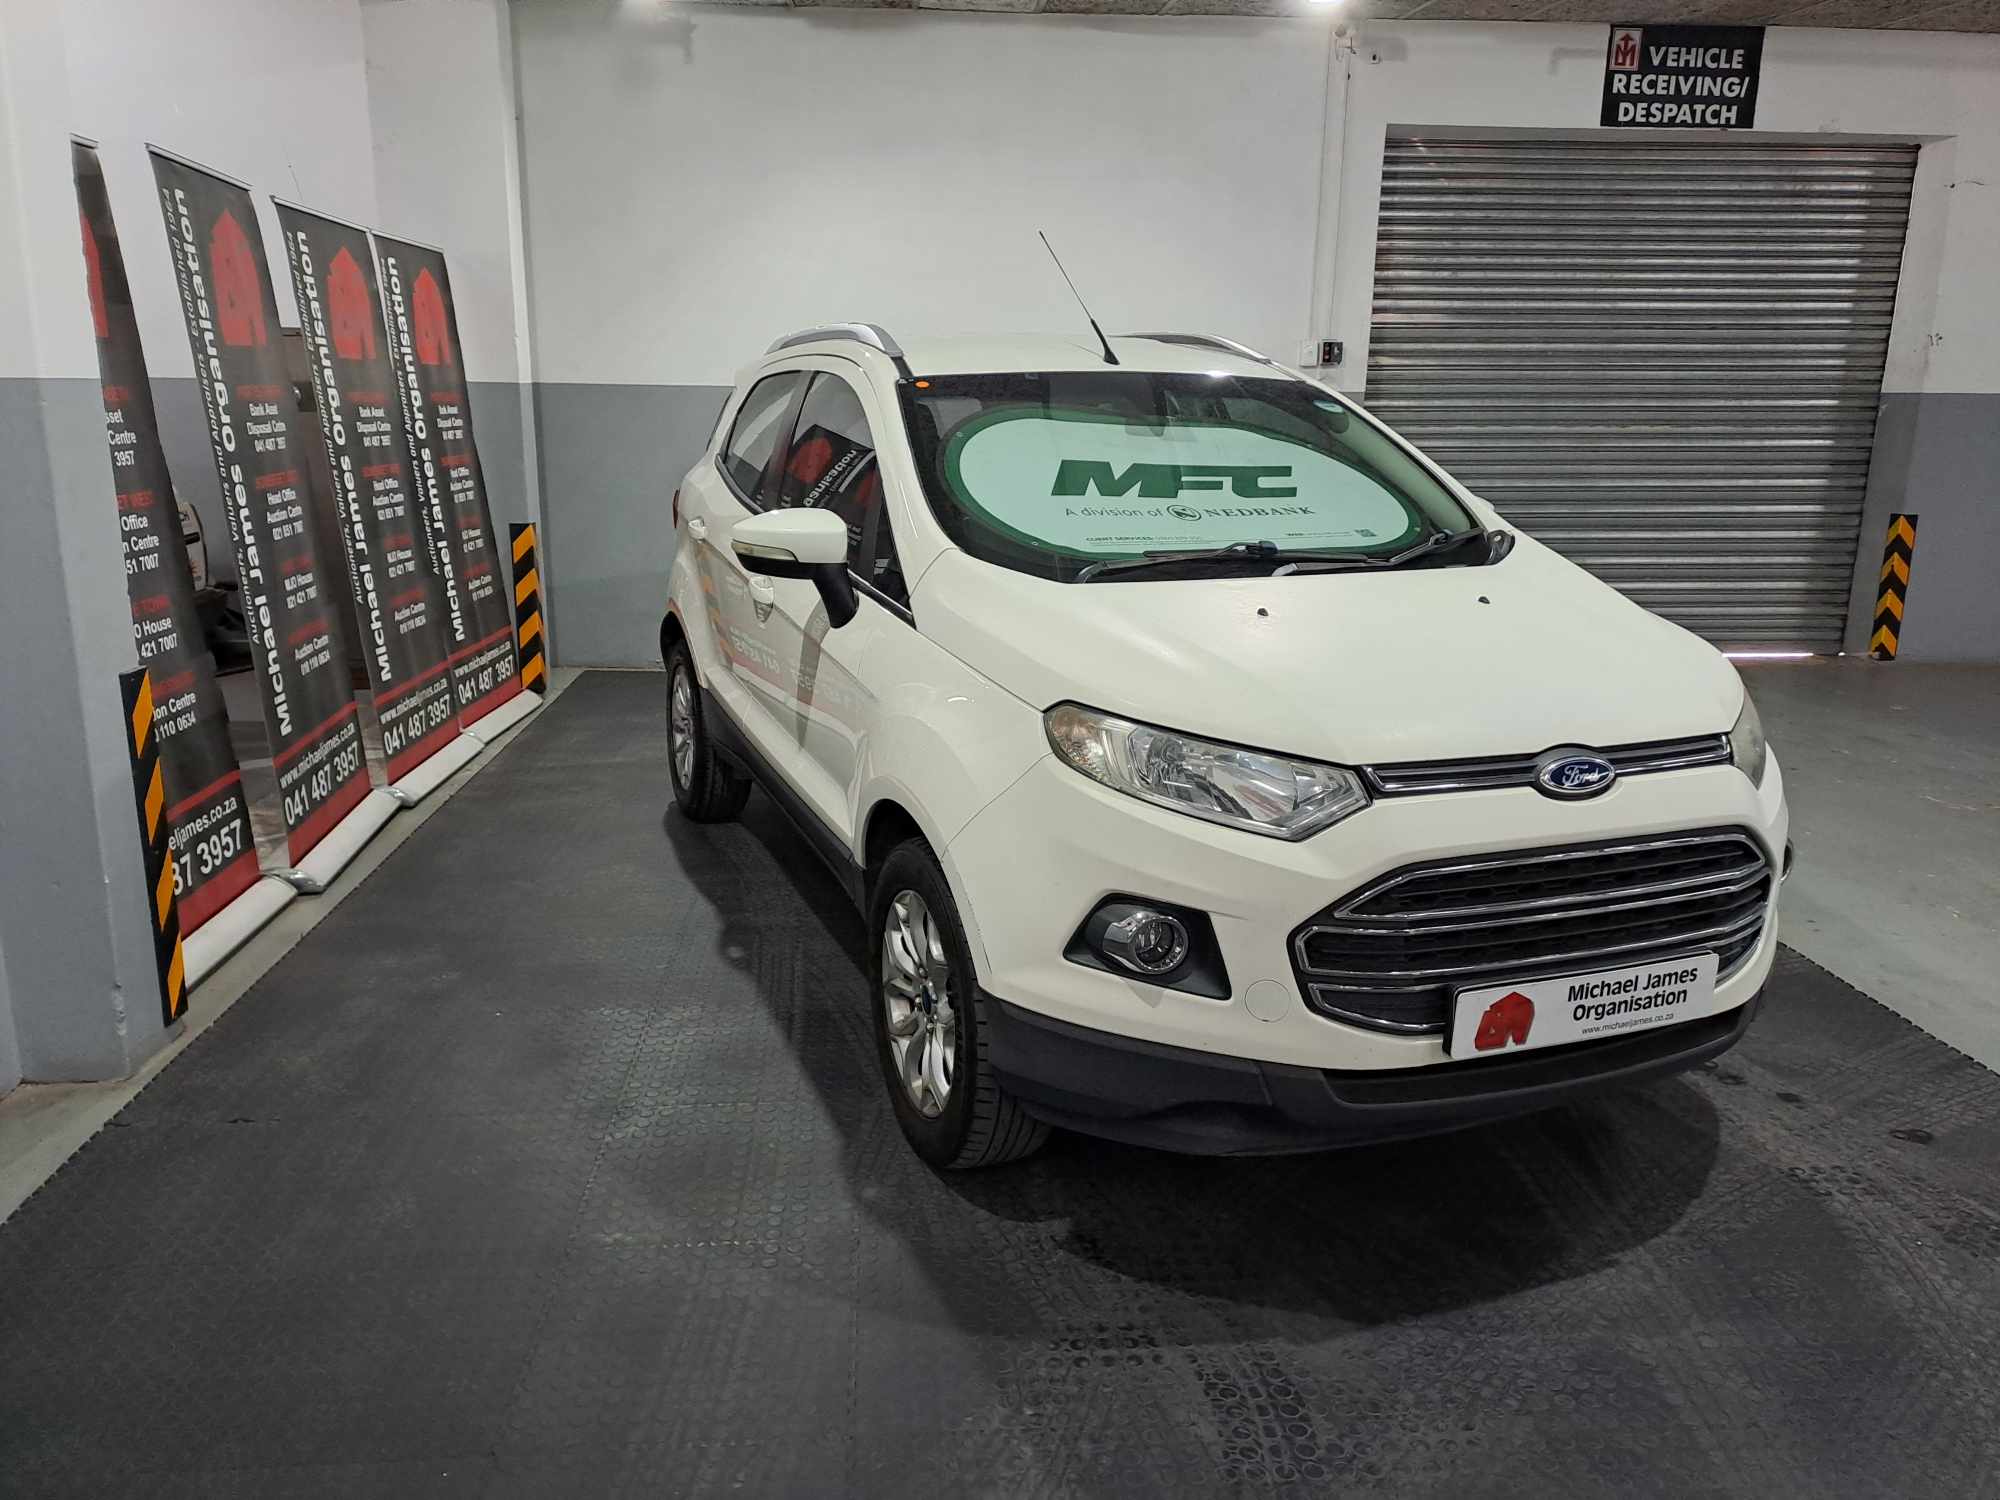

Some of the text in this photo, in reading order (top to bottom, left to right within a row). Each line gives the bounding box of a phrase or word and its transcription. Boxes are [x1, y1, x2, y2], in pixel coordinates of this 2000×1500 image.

[1649, 46, 1745, 69] VEHICLE
[1612, 73, 1750, 98] RECEIVING/
[1617, 102, 1738, 125] DESPATCH
[196, 352, 220, 440] Appraisers
[107, 430, 137, 445] Centre
[385, 254, 464, 641] Michael James Organisation
[407, 433, 416, 456] and
[114, 450, 135, 466] 3957
[172, 186, 292, 737] Michael James Organisation
[214, 445, 226, 476] and
[294, 229, 391, 682] Michael James Organisation
[325, 439, 336, 464] and
[411, 459, 425, 501] Valuers
[1050, 459, 1298, 498] MFC
[120, 514, 149, 531] Office
[221, 482, 239, 540] Valuers
[1065, 504, 1317, 519] A division of NEDBANK
[130, 534, 160, 551] Centre
[139, 553, 159, 571] 7007
[235, 547, 259, 645] Auctioneers,
[142, 617, 172, 636] House
[141, 633, 178, 658] 421 7007
[458, 654, 514, 704] 041 487 3957
[169, 692, 197, 713] Centre
[176, 711, 196, 731] 0634
[383, 694, 451, 755] 041 487 3957
[284, 740, 359, 826] 041 487 3957
[1562, 764, 1600, 786] Ford
[196, 818, 241, 874] 3957
[1567, 967, 1698, 1002] Michael James
[1572, 987, 1688, 1021] Organisation
